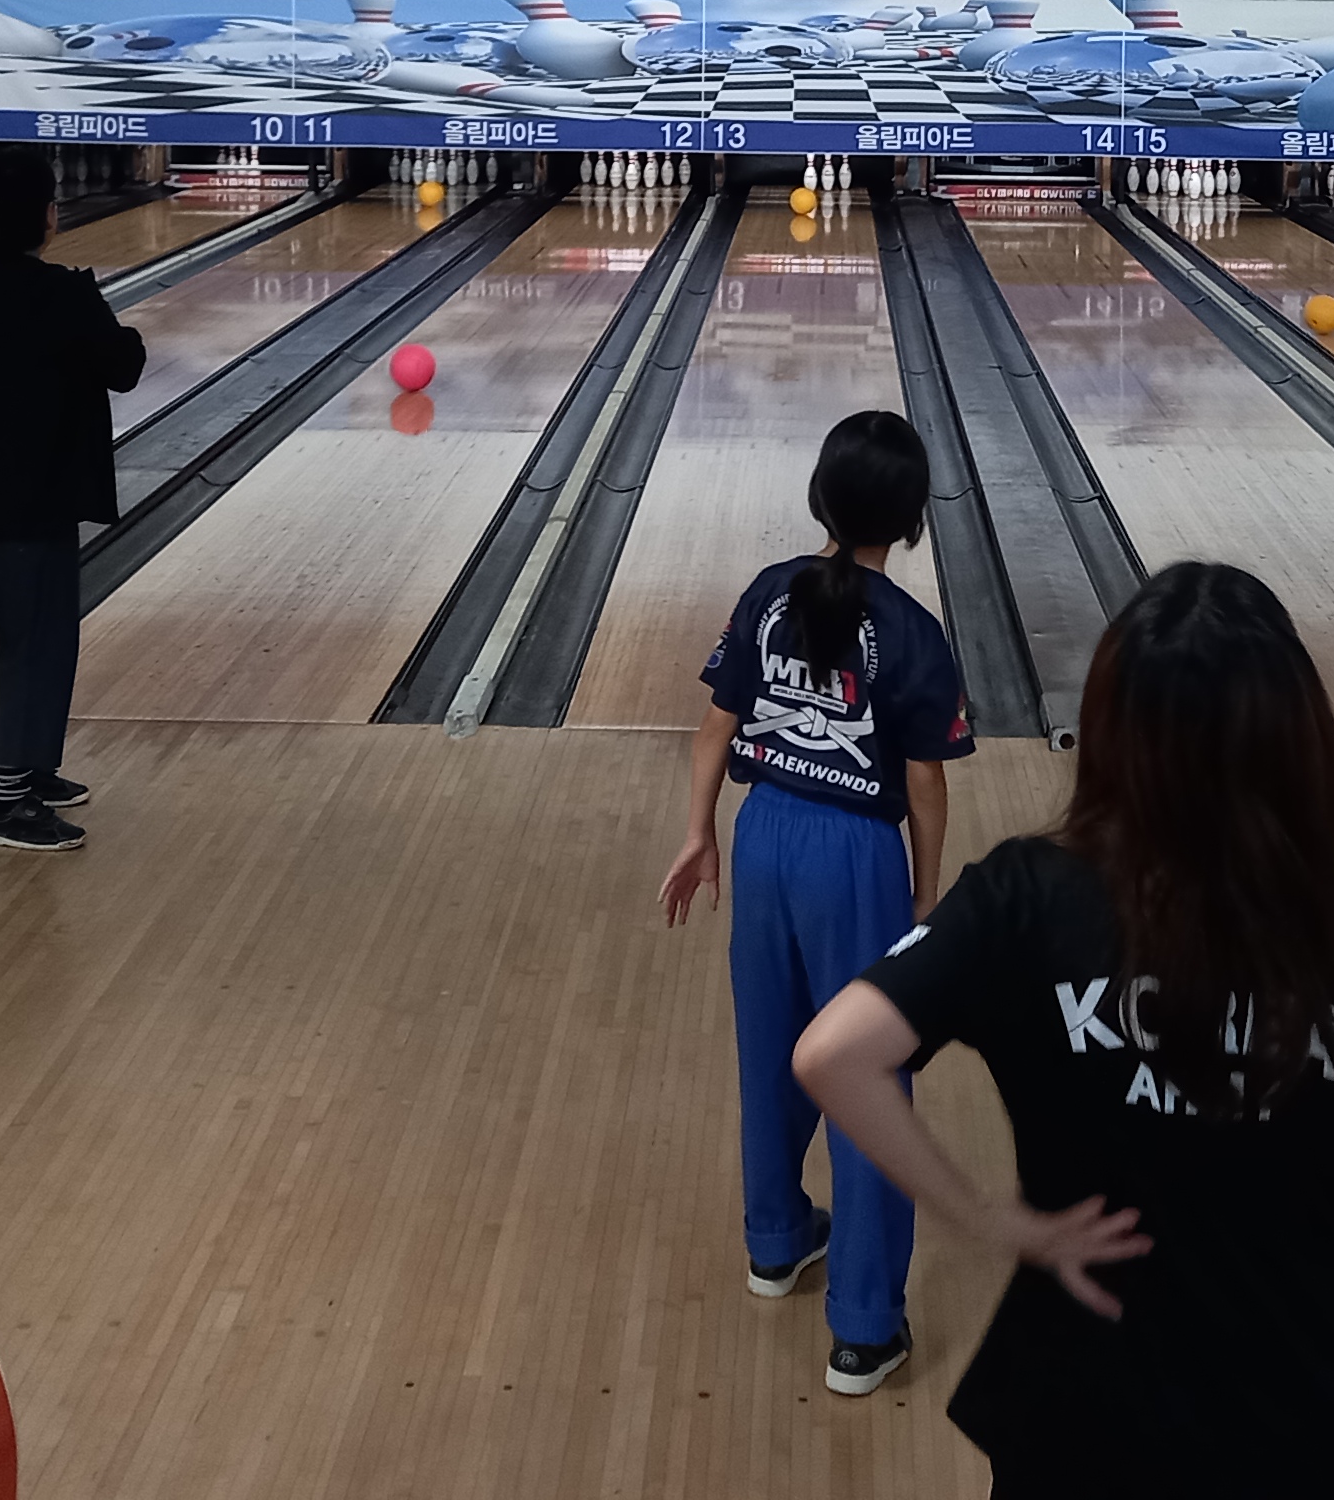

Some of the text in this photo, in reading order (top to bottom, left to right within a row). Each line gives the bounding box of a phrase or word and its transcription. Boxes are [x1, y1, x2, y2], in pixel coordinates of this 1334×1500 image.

[34, 113, 148, 138] 올림피아드
[251, 117, 283, 142] 10
[304, 118, 333, 142] 11
[442, 119, 559, 146] 올림피아드
[660, 123, 693, 148] 12
[713, 123, 746, 149] 13
[855, 124, 975, 151] 올림피아드
[1081, 126, 1115, 151] 14
[1133, 128, 1167, 153] 15
[1033, 189, 1083, 199] BOWLING
[763, 747, 881, 797] TAEKWONDO
